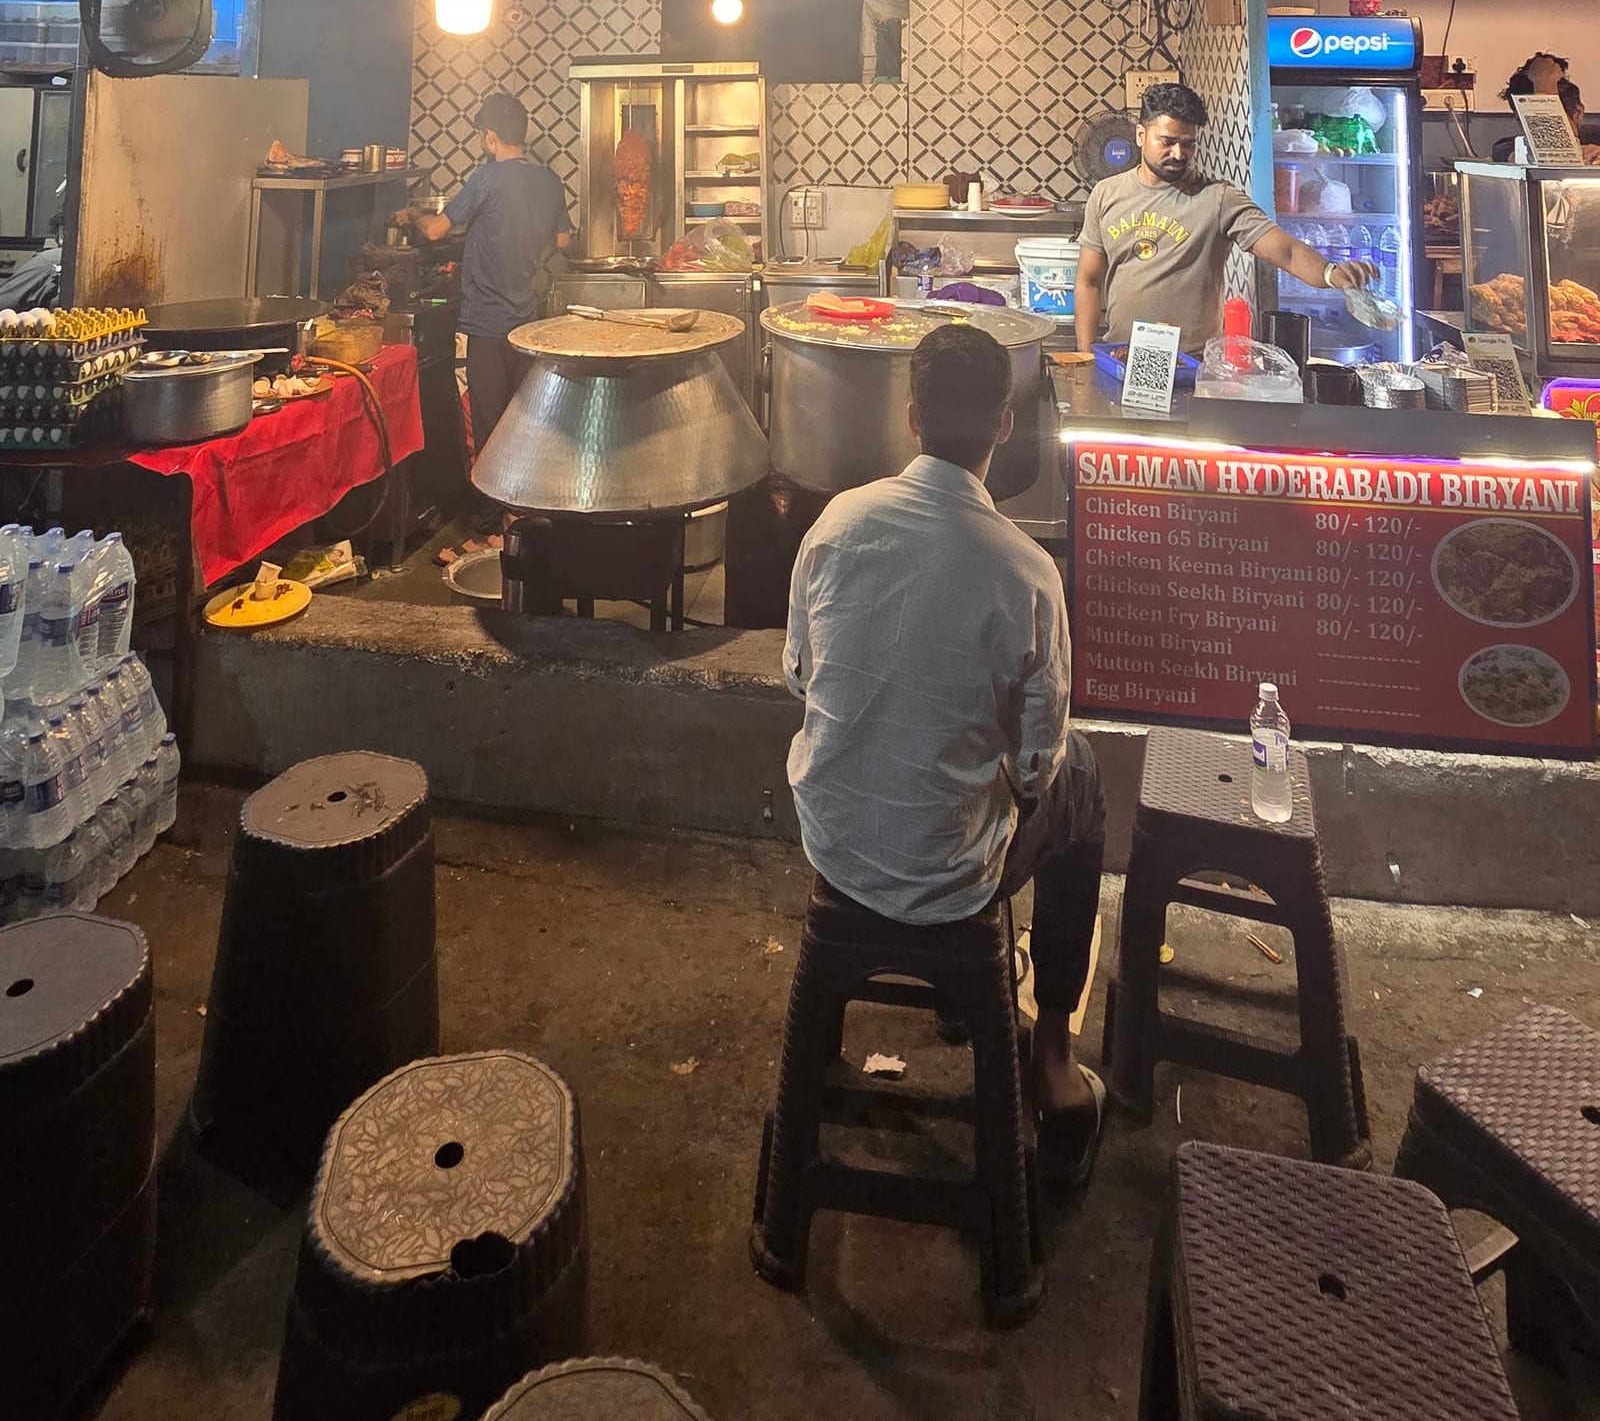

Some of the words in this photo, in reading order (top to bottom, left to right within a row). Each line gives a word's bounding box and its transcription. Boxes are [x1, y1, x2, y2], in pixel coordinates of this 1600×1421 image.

[1324, 32, 1389, 55] pepsi
[1107, 211, 1190, 244] BALMAIN
[1134, 230, 1158, 239] PARIS
[1078, 451, 1208, 493] SALMAN
[1215, 459, 1433, 506] HYDERABADI
[1440, 472, 1580, 514] BIRYANI
[1085, 497, 1161, 519] Chicken
[1167, 503, 1239, 526] Biryani
[1314, 513, 1359, 536] 80/-
[1364, 514, 1422, 540] 120/-
[1085, 522, 1162, 545] Chicken
[1167, 530, 1192, 547] 65
[1198, 532, 1270, 555] Biryani
[1315, 540, 1360, 562] 80/-
[1365, 542, 1423, 566] 120/-
[1085, 548, 1162, 571] Chicken
[1167, 555, 1234, 576] Keema
[1239, 560, 1313, 584] Biryani
[1316, 567, 1360, 589] 80/-
[1366, 569, 1424, 593] 120/-
[1085, 574, 1162, 596] Chicken
[1166, 581, 1226, 602] Seekh
[1231, 586, 1305, 610] Biryani
[1316, 593, 1361, 615] 80/-
[1366, 595, 1424, 620] 120/-
[1085, 600, 1163, 623] Chicken
[1168, 607, 1200, 630] Fry
[1205, 610, 1277, 634] Biryani
[1316, 619, 1361, 641] 80/-
[1366, 622, 1424, 647] 120/-
[1085, 625, 1154, 648] Mutton
[1160, 633, 1233, 656] Biryani
[1085, 652, 1155, 674] Mutton
[1160, 658, 1219, 681] Seekh
[1224, 664, 1298, 687] Biryani
[1085, 678, 1120, 701] Egg
[1124, 682, 1197, 706] Biryani
